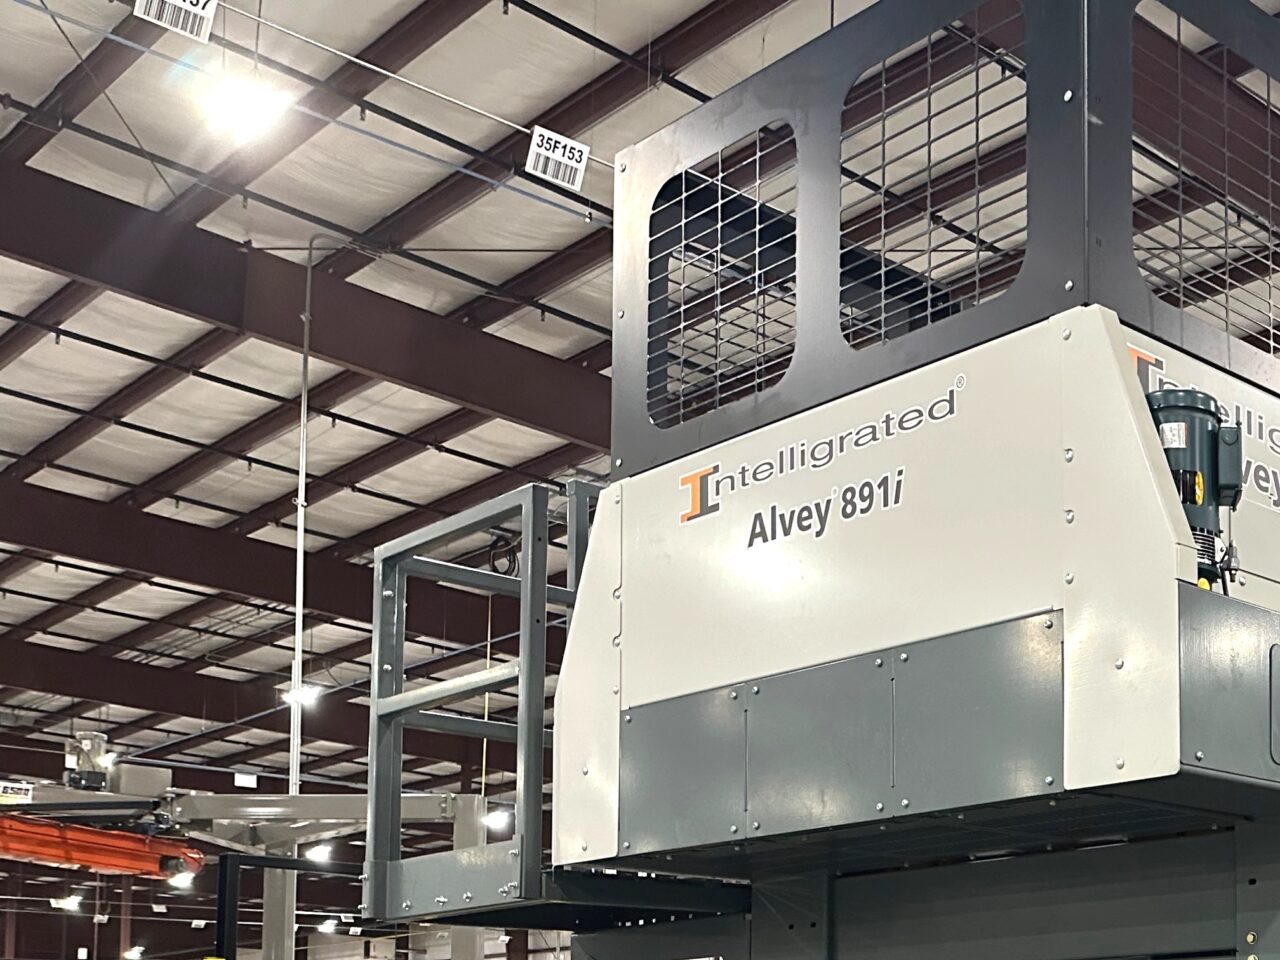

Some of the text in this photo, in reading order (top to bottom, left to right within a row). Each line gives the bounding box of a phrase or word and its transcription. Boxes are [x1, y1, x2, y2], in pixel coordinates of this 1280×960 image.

[536, 133, 584, 164] 35F153
[747, 469, 904, 549] Alvey 891i
